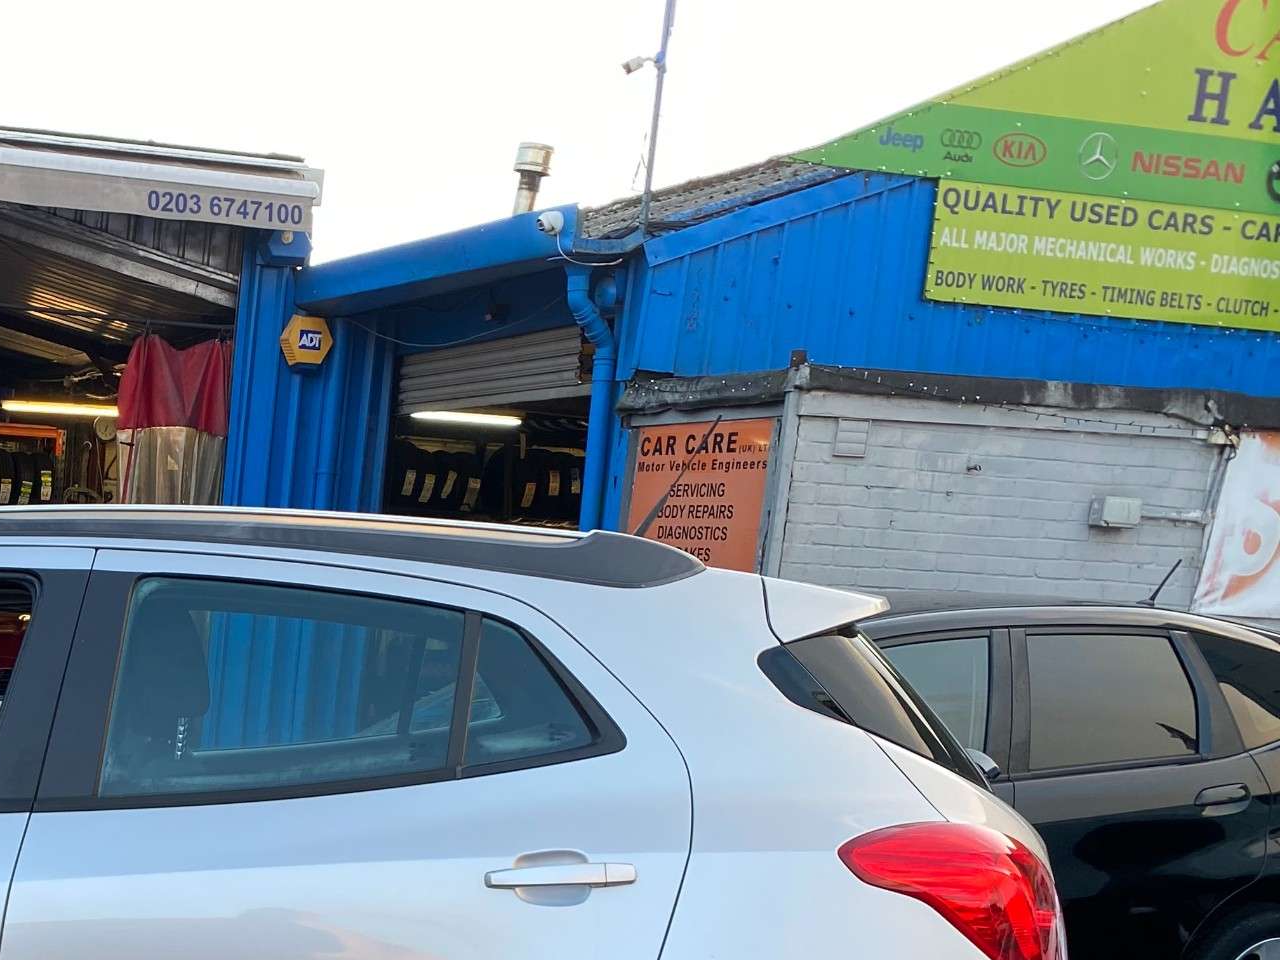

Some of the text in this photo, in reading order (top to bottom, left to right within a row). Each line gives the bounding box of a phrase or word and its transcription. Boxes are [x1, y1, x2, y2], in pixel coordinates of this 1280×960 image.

[879, 126, 924, 152] Jeep
[1002, 139, 1037, 161] KIA
[943, 151, 973, 163] Audi
[1131, 151, 1246, 184] NISSAN
[147, 190, 303, 225] 0203 6747100
[942, 187, 1062, 220] QUALITY
[1070, 201, 1139, 228] USED
[1147, 209, 1215, 235] CARS
[940, 227, 969, 249] ALL
[974, 230, 1028, 255] MAJOR
[1033, 236, 1135, 266] MECHANICAL
[1140, 246, 1197, 271] WORKS
[934, 270, 977, 289] BODY
[981, 274, 1027, 294] WORK
[1042, 280, 1087, 300] TYRES
[1101, 285, 1156, 307] TIMING
[1160, 291, 1203, 311] BELTS
[1216, 297, 1270, 317] CLUTCH
[299, 333, 321, 347] ADT
[640, 435, 677, 457] CAR
[685, 431, 739, 455] CARE
[637, 459, 768, 473] Motor Vehicle Engineers
[669, 482, 726, 498] SERVICING
[687, 504, 734, 519] REPAIRS
[656, 525, 728, 541] DIAGNOSTICS
